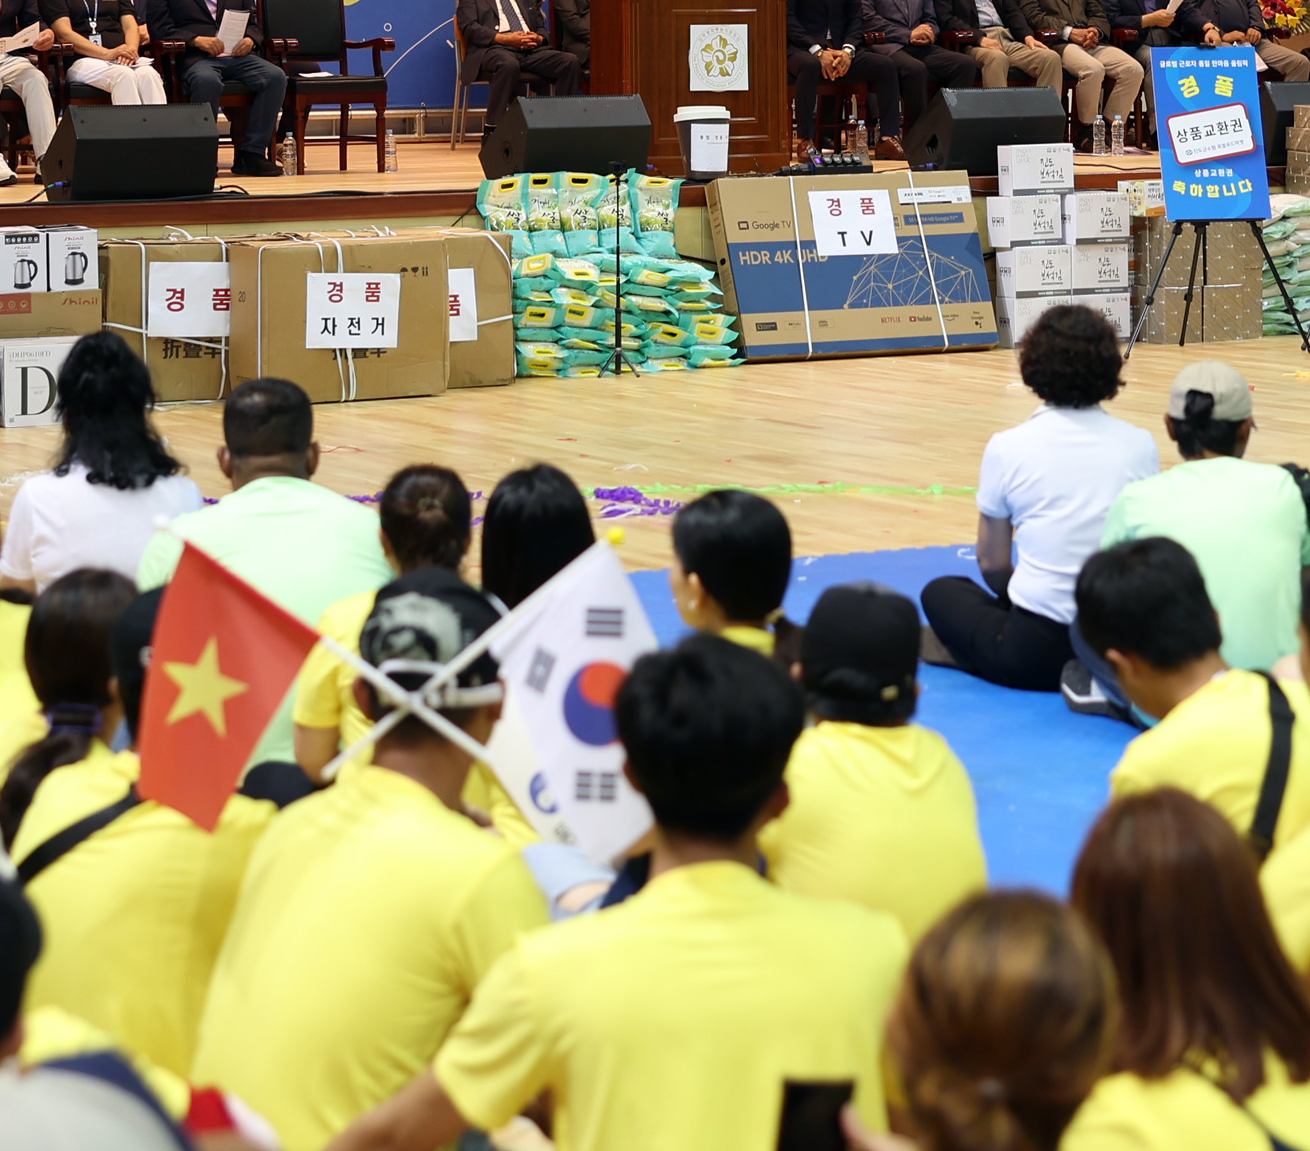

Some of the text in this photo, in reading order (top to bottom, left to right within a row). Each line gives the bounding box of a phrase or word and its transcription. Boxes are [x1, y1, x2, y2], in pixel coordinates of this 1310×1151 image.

[1160, 59, 1248, 68] 글로벌 근로자 통일 한마음 올림픽
[1176, 118, 1244, 144] 상품교환권
[1040, 158, 1055, 167] 진도
[1194, 169, 1233, 177] 상품교환권
[1173, 179, 1253, 198] 축하합니다
[1033, 208, 1046, 218] 진도
[1100, 207, 1114, 216] 진도
[752, 220, 791, 231] Google TV
[739, 251, 771, 265] HDR
[774, 250, 794, 263] 4K
[1098, 257, 1112, 267] 진도
[1041, 259, 1054, 269] 진도
[15, 366, 57, 417] D
